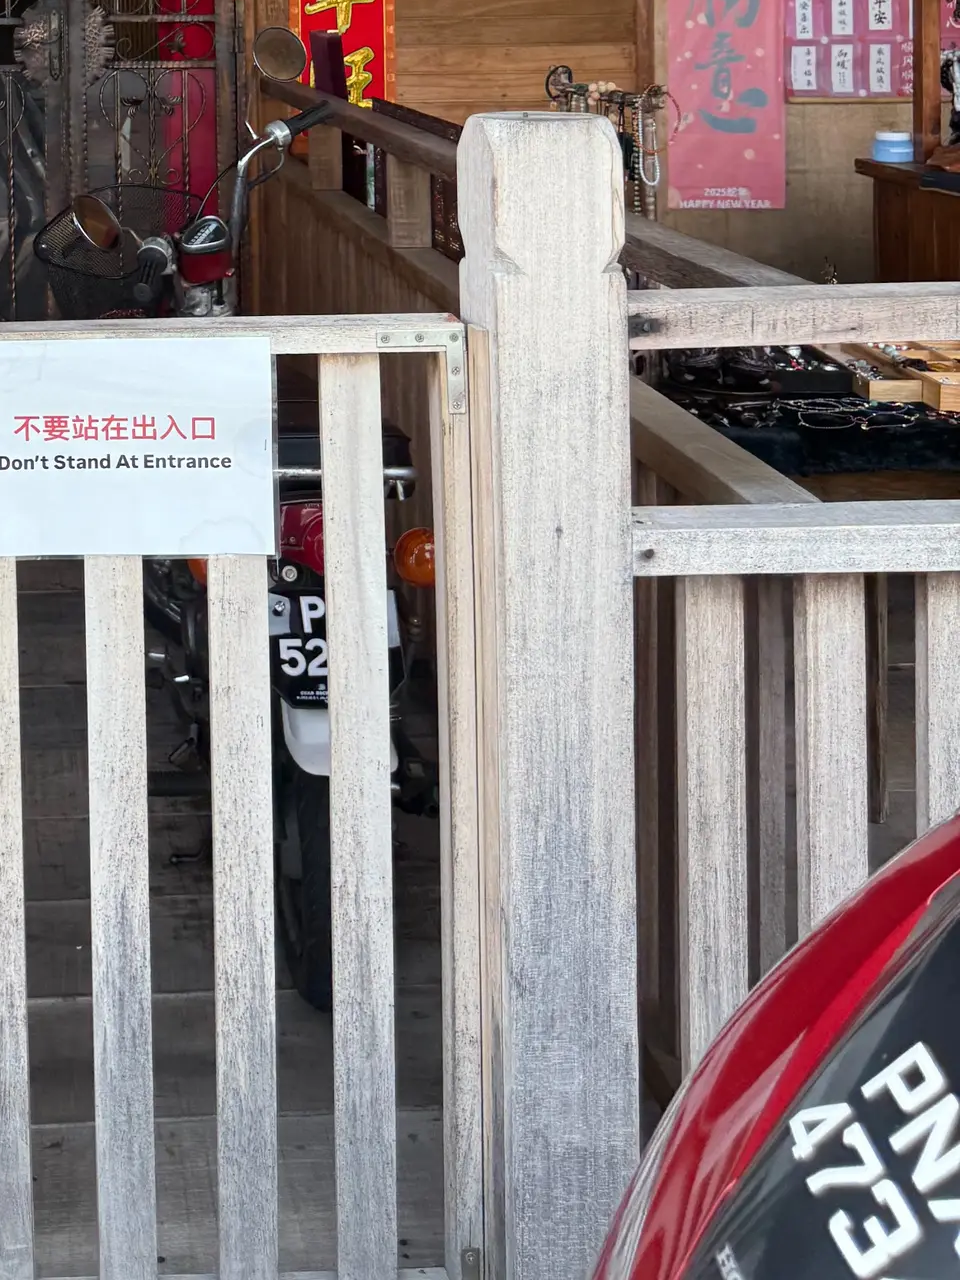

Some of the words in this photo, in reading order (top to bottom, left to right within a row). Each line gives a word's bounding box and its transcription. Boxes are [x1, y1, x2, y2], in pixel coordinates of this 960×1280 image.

[680, 200, 714, 209] HAPPY
[717, 200, 741, 209] NEW
[744, 200, 771, 209] YEAR
[14, 415, 215, 441] 不要站在出入口
[54, 454, 111, 470] Stand
[116, 454, 138, 469] At
[144, 454, 232, 469] Entrance
[299, 596, 325, 634] P
[279, 638, 328, 677] 52
[861, 1041, 960, 1258] PN
[789, 1102, 924, 1280] 473
